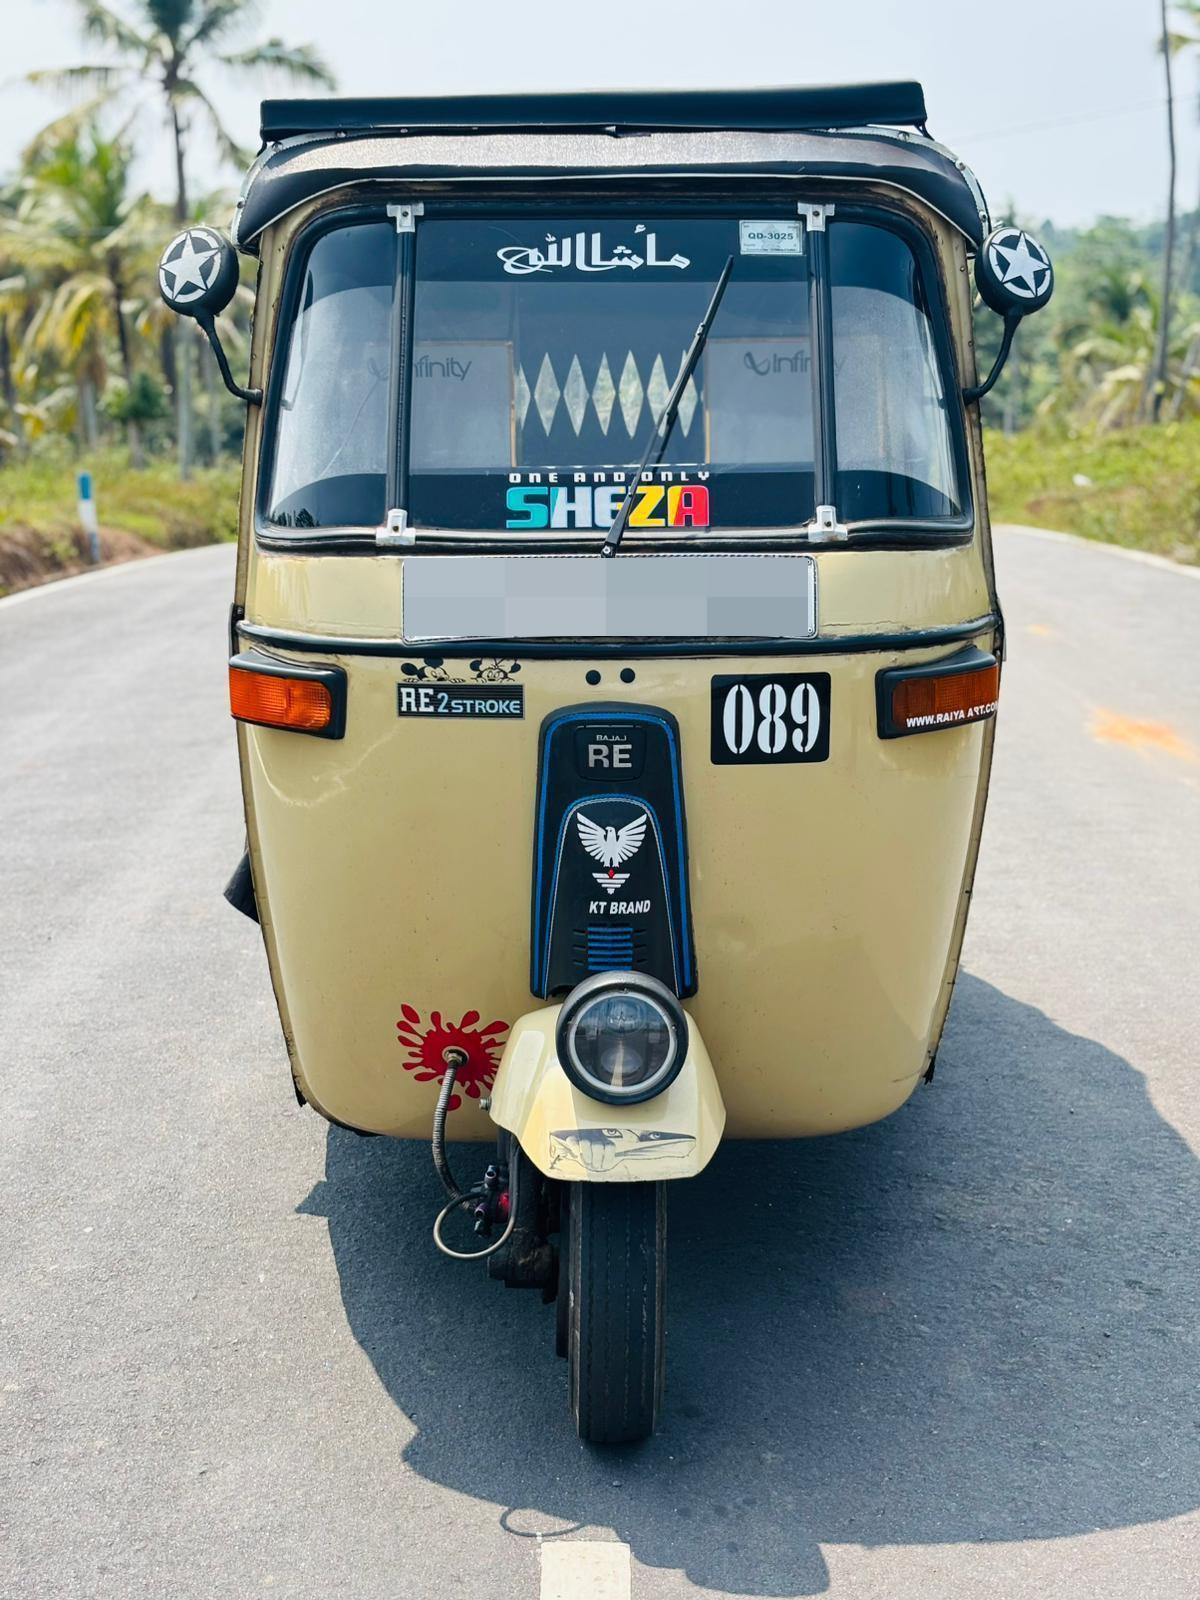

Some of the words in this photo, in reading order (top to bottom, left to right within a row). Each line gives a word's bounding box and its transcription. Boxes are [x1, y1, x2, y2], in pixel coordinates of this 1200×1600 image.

[748, 232, 794, 240] QD-3025
[509, 472, 558, 483] ONE
[574, 472, 626, 483] AND
[641, 471, 710, 482] ONLY
[506, 485, 710, 528] SHEZA
[400, 687, 434, 712] RE
[723, 682, 820, 754] 089
[906, 710, 965, 727] WWW.RAIYA
[588, 744, 632, 768] RE
[589, 901, 607, 914] KT
[609, 900, 651, 914] BRAND
